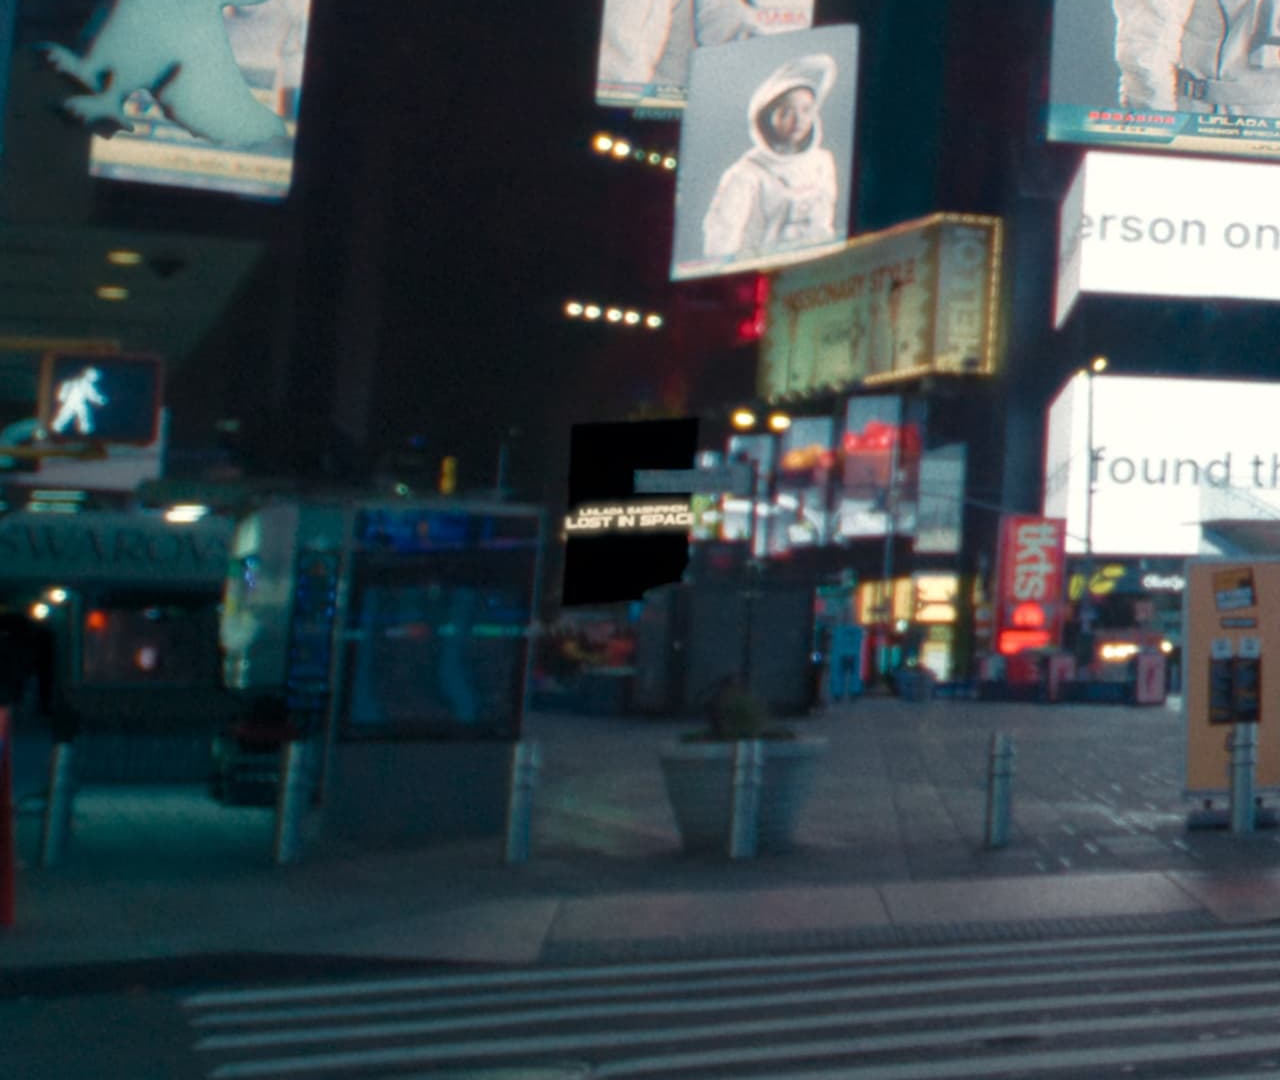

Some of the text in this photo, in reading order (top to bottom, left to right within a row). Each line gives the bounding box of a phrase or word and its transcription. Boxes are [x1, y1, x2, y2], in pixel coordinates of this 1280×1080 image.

[1197, 115, 1269, 129] LINLADA
[1224, 221, 1280, 251] on
[1090, 446, 1232, 485] found
[565, 516, 613, 530] LOST
[618, 515, 635, 527] IN
[1013, 523, 1057, 600] tkts
